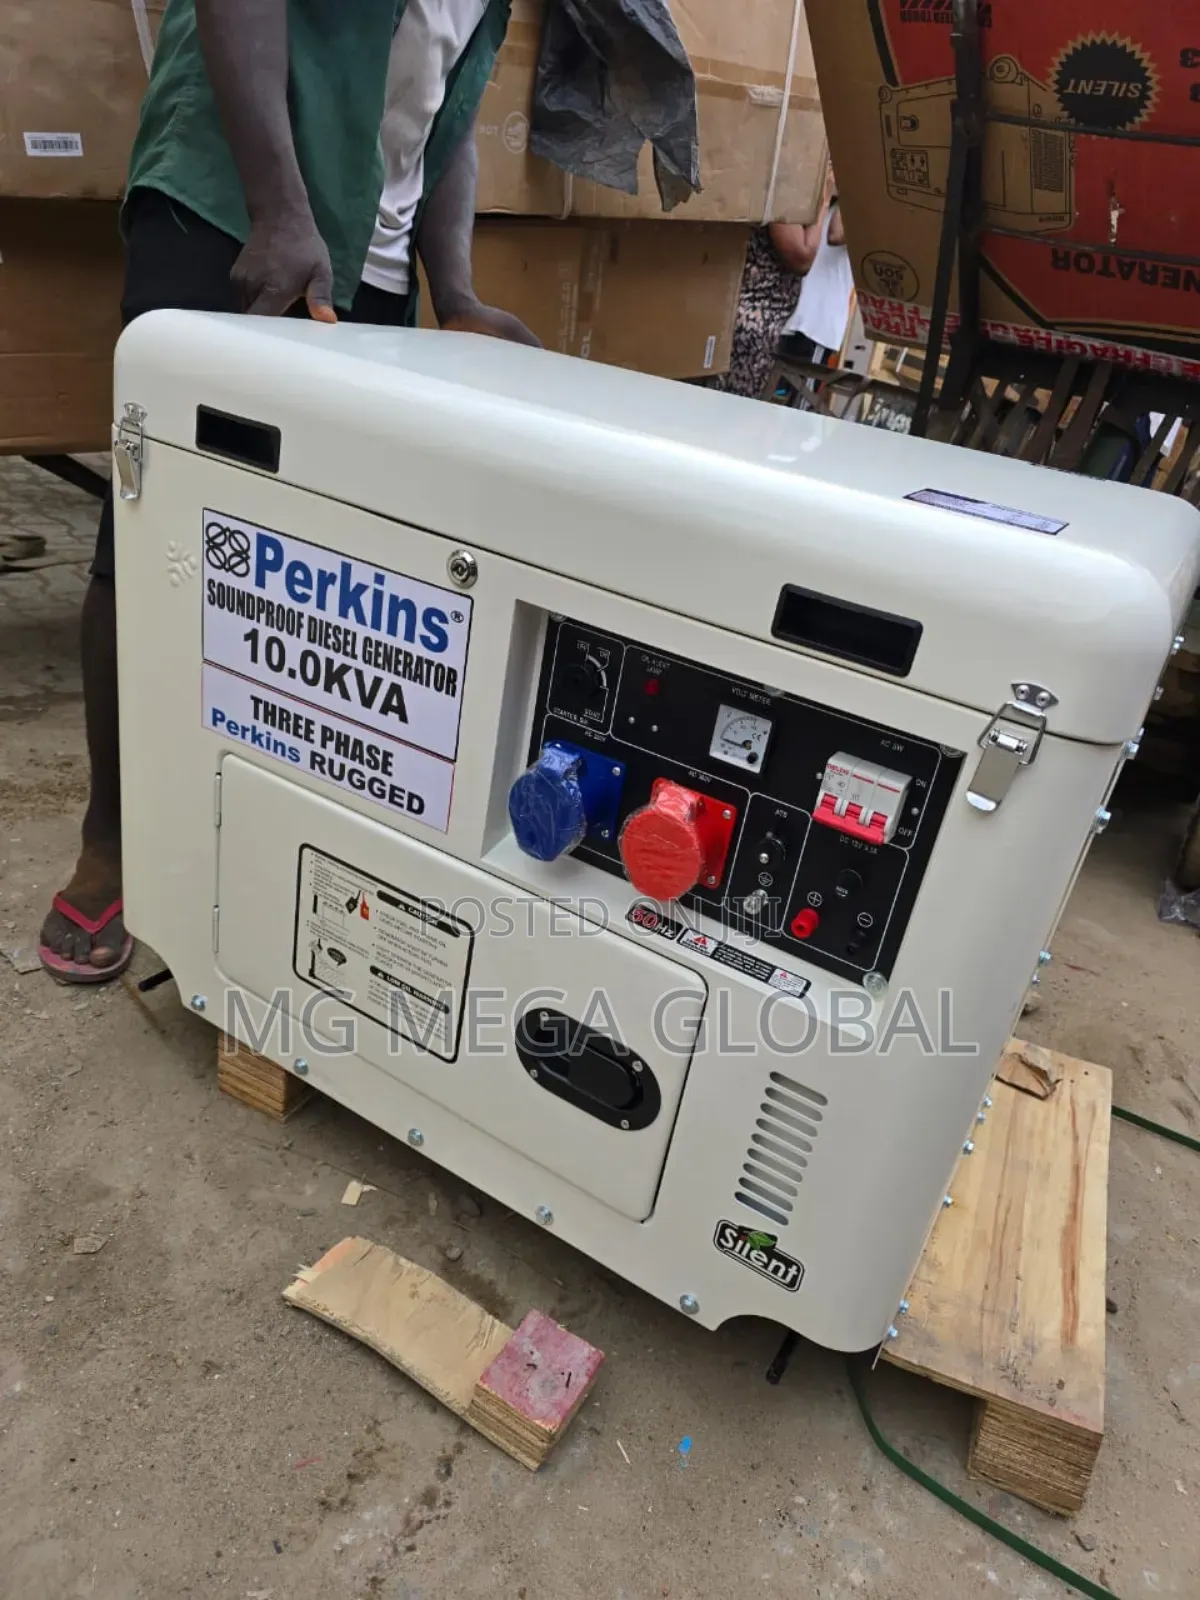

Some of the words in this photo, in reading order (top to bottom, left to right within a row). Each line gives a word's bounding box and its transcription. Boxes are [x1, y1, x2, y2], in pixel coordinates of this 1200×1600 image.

[1065, 79, 1143, 98] SILENT
[207, 578, 304, 639] SOUNDPROOF
[307, 615, 358, 660] DIESEL
[362, 636, 459, 698] GENERATOR
[243, 628, 409, 724] 10.0KVA
[211, 707, 301, 763] Perkins
[310, 751, 425, 816] RUGGED
[251, 694, 315, 745] THREE
[321, 728, 394, 778] PHASE
[720, 1228, 798, 1283] Silent
